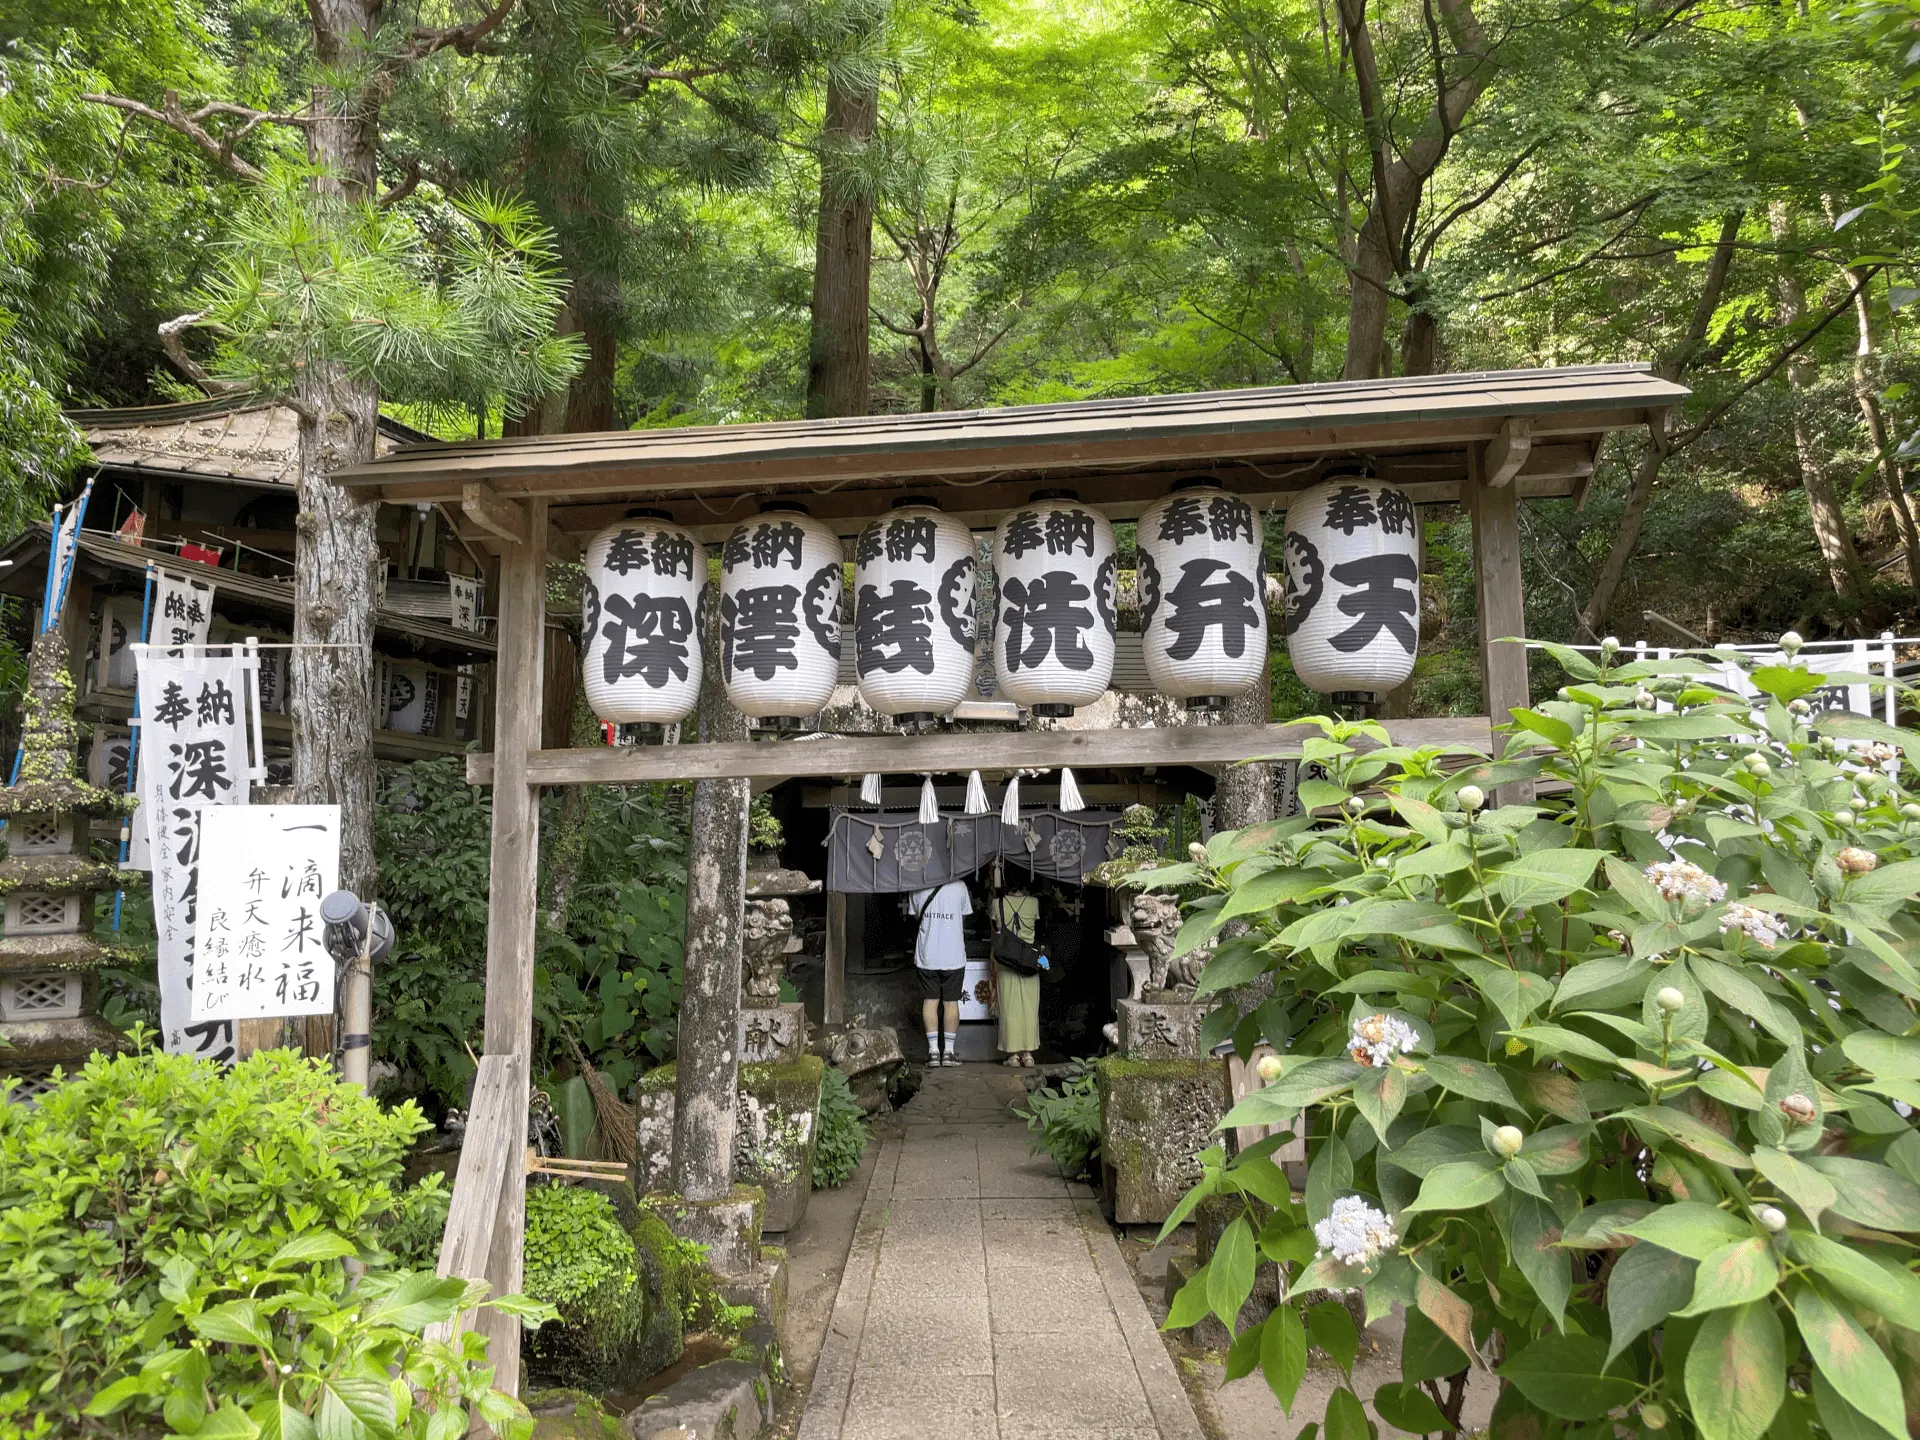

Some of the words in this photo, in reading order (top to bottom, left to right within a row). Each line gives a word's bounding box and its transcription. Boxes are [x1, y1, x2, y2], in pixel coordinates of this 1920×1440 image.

[1003, 510, 1095, 559] 奉納
[1158, 497, 1254, 545] 奉納
[1322, 486, 1416, 539] 奉納
[604, 529, 694, 581] 奉納
[723, 522, 805, 574] 奉納
[856, 517, 938, 570] 奉納
[454, 584, 474, 603] 奉納
[1164, 558, 1260, 661] 弁
[1327, 554, 1418, 655] 天
[603, 592, 694, 688] 深
[1002, 571, 1095, 673] 洗
[154, 679, 235, 733] 奉納
[238, 867, 270, 990] 弁天癒水
[274, 825, 328, 1004] 一滴来福
[202, 908, 231, 1009] 良縁結び
